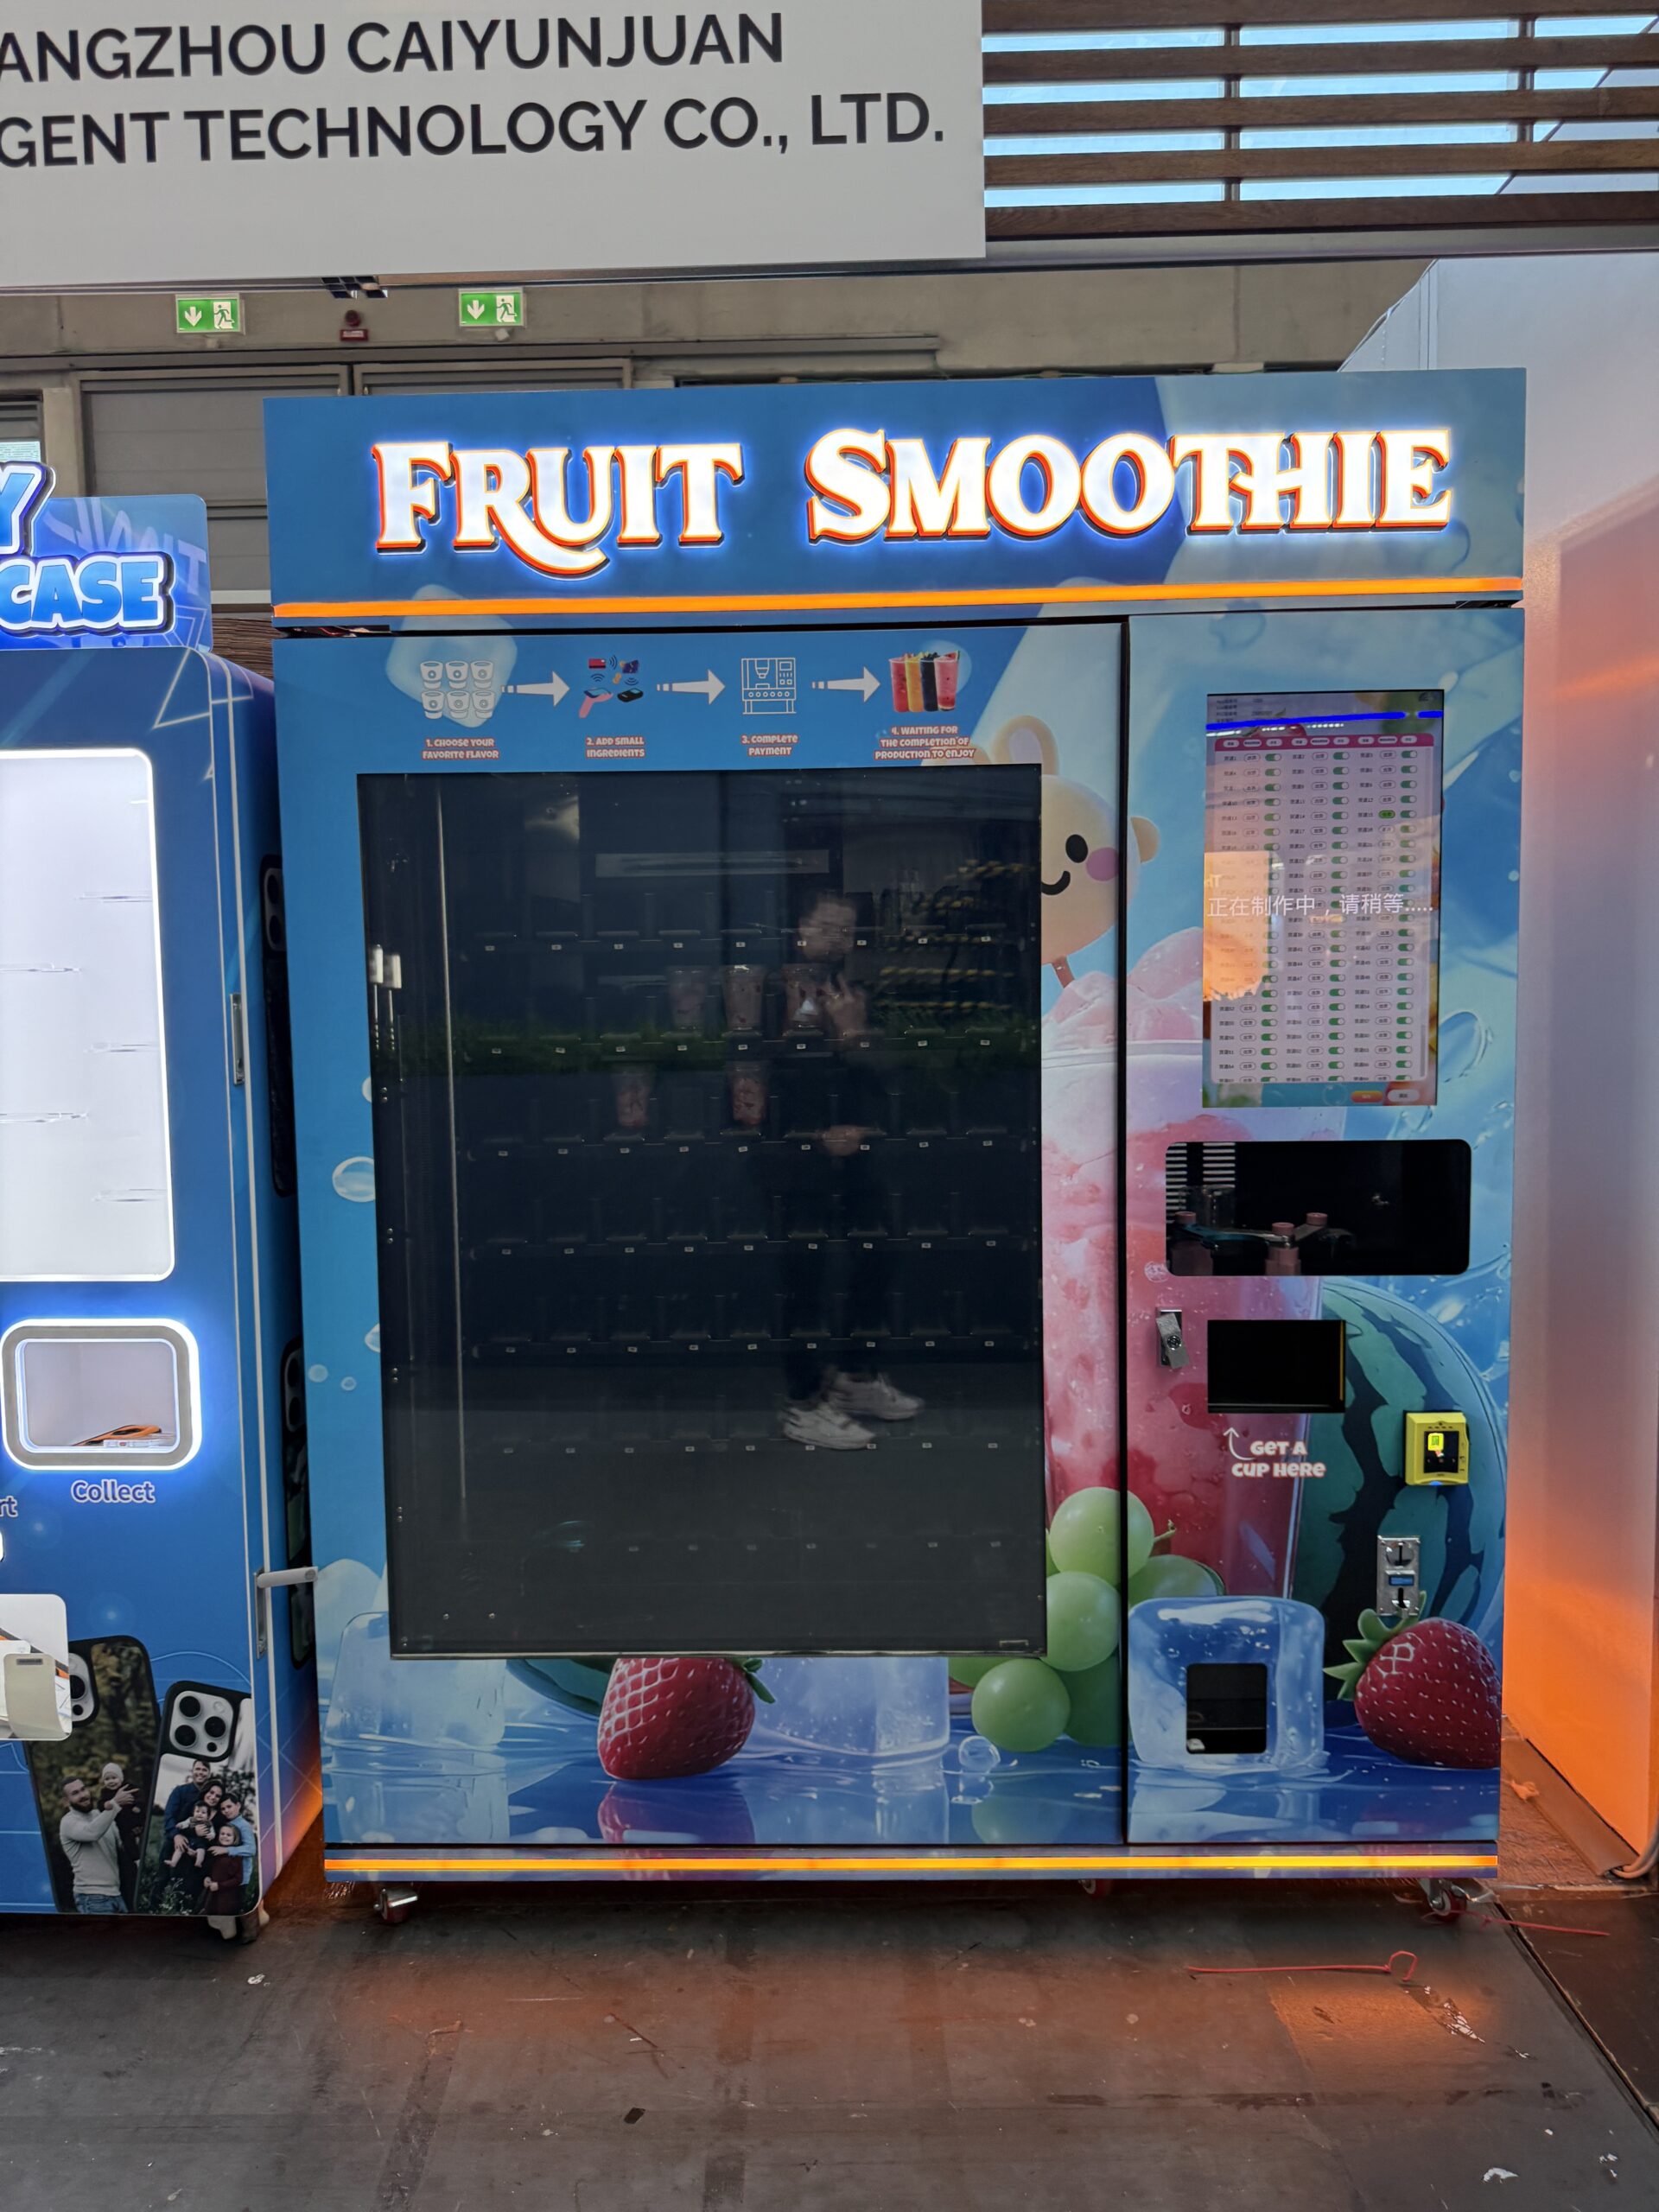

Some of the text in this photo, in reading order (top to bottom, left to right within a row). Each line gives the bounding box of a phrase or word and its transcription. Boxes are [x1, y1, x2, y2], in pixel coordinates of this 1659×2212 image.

[0, 12, 783, 82] ANGZHOU CAIYUNJUAN
[0, 92, 944, 168] GENT TECHNOLOGY CO., LTD.
[372, 428, 1453, 577] FRUIT SMOOTHIE
[900, 726, 939, 734] WAITING
[941, 726, 958, 734] FOR
[470, 738, 495, 747] YOUR
[595, 737, 613, 746] ADD
[614, 736, 645, 746] SMALL
[957, 737, 969, 746] OF
[466, 750, 499, 759] FLAVOR
[931, 749, 944, 758] TO
[1292, 1440, 1307, 1455] A
[1231, 1462, 1270, 1478] CUP
[71, 1479, 156, 1503] Collect
